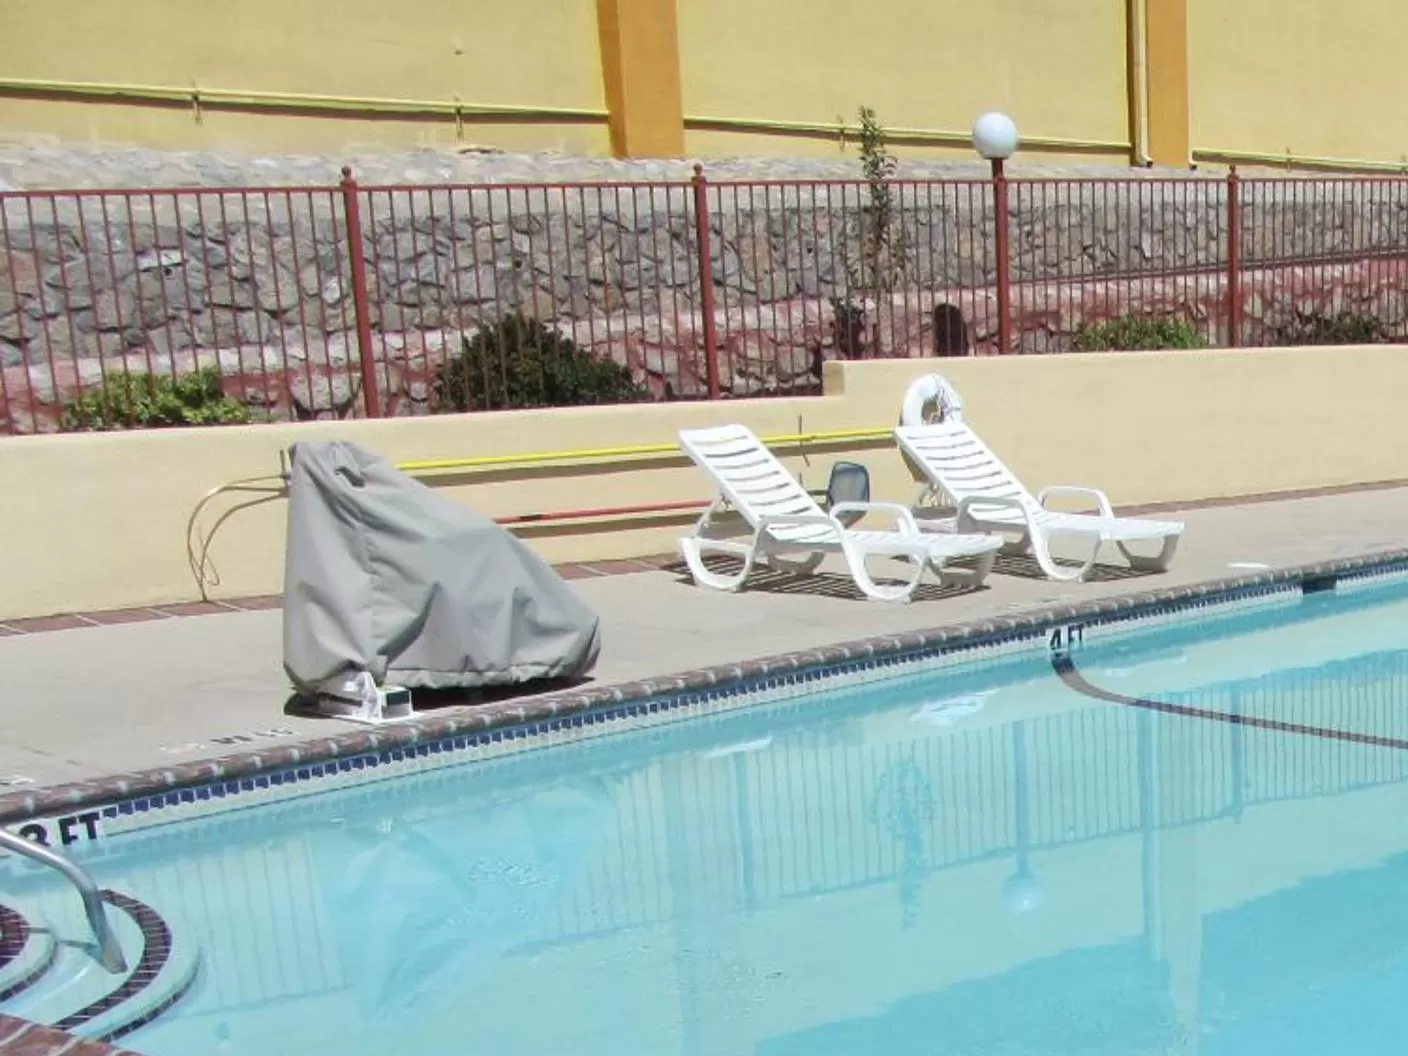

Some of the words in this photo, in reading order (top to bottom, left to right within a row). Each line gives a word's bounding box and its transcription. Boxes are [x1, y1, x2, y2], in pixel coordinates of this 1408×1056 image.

[1050, 628, 1062, 650] 4
[1067, 624, 1084, 643] FT
[58, 812, 100, 845] FT
